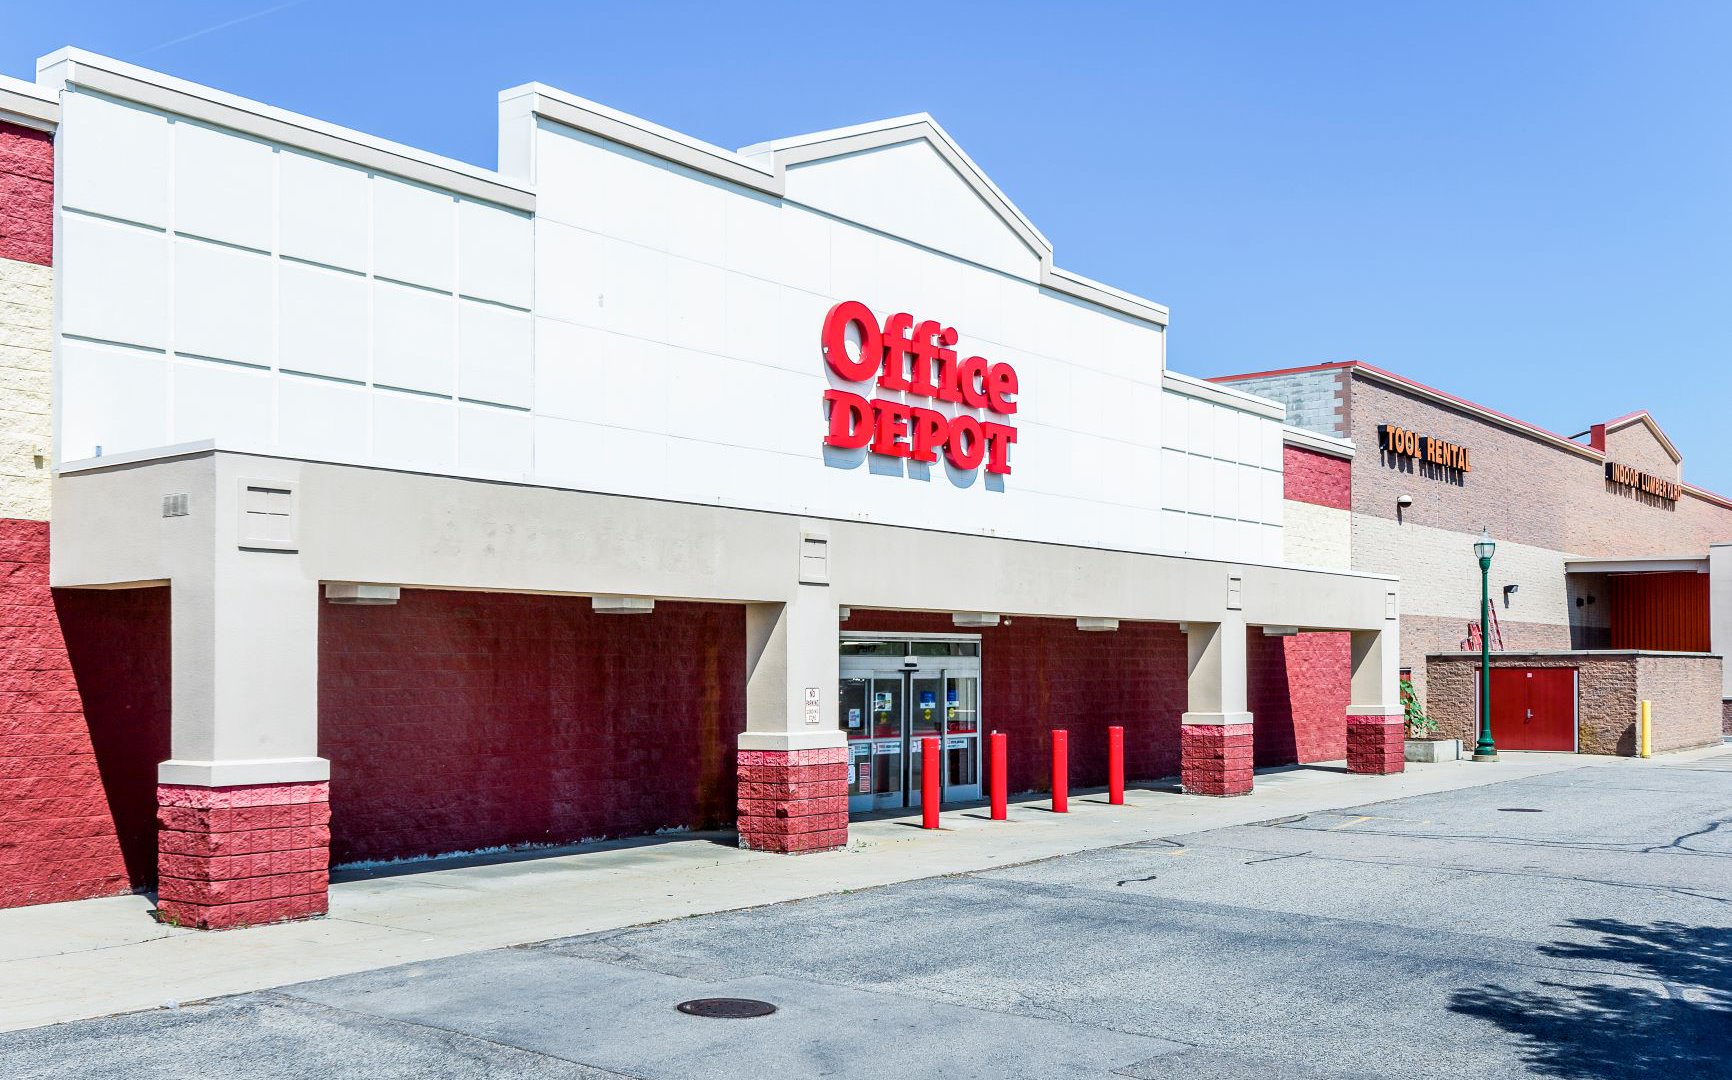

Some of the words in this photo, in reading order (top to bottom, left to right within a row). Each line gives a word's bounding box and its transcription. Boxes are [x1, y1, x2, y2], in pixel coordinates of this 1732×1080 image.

[821, 301, 1018, 414] Office
[824, 389, 1017, 475] DEPOT
[1385, 424, 1422, 459] TOOL
[1427, 436, 1472, 472] RENTAL
[1611, 462, 1639, 488] INDOOR
[1641, 472, 1682, 501] LUMBERYARD
